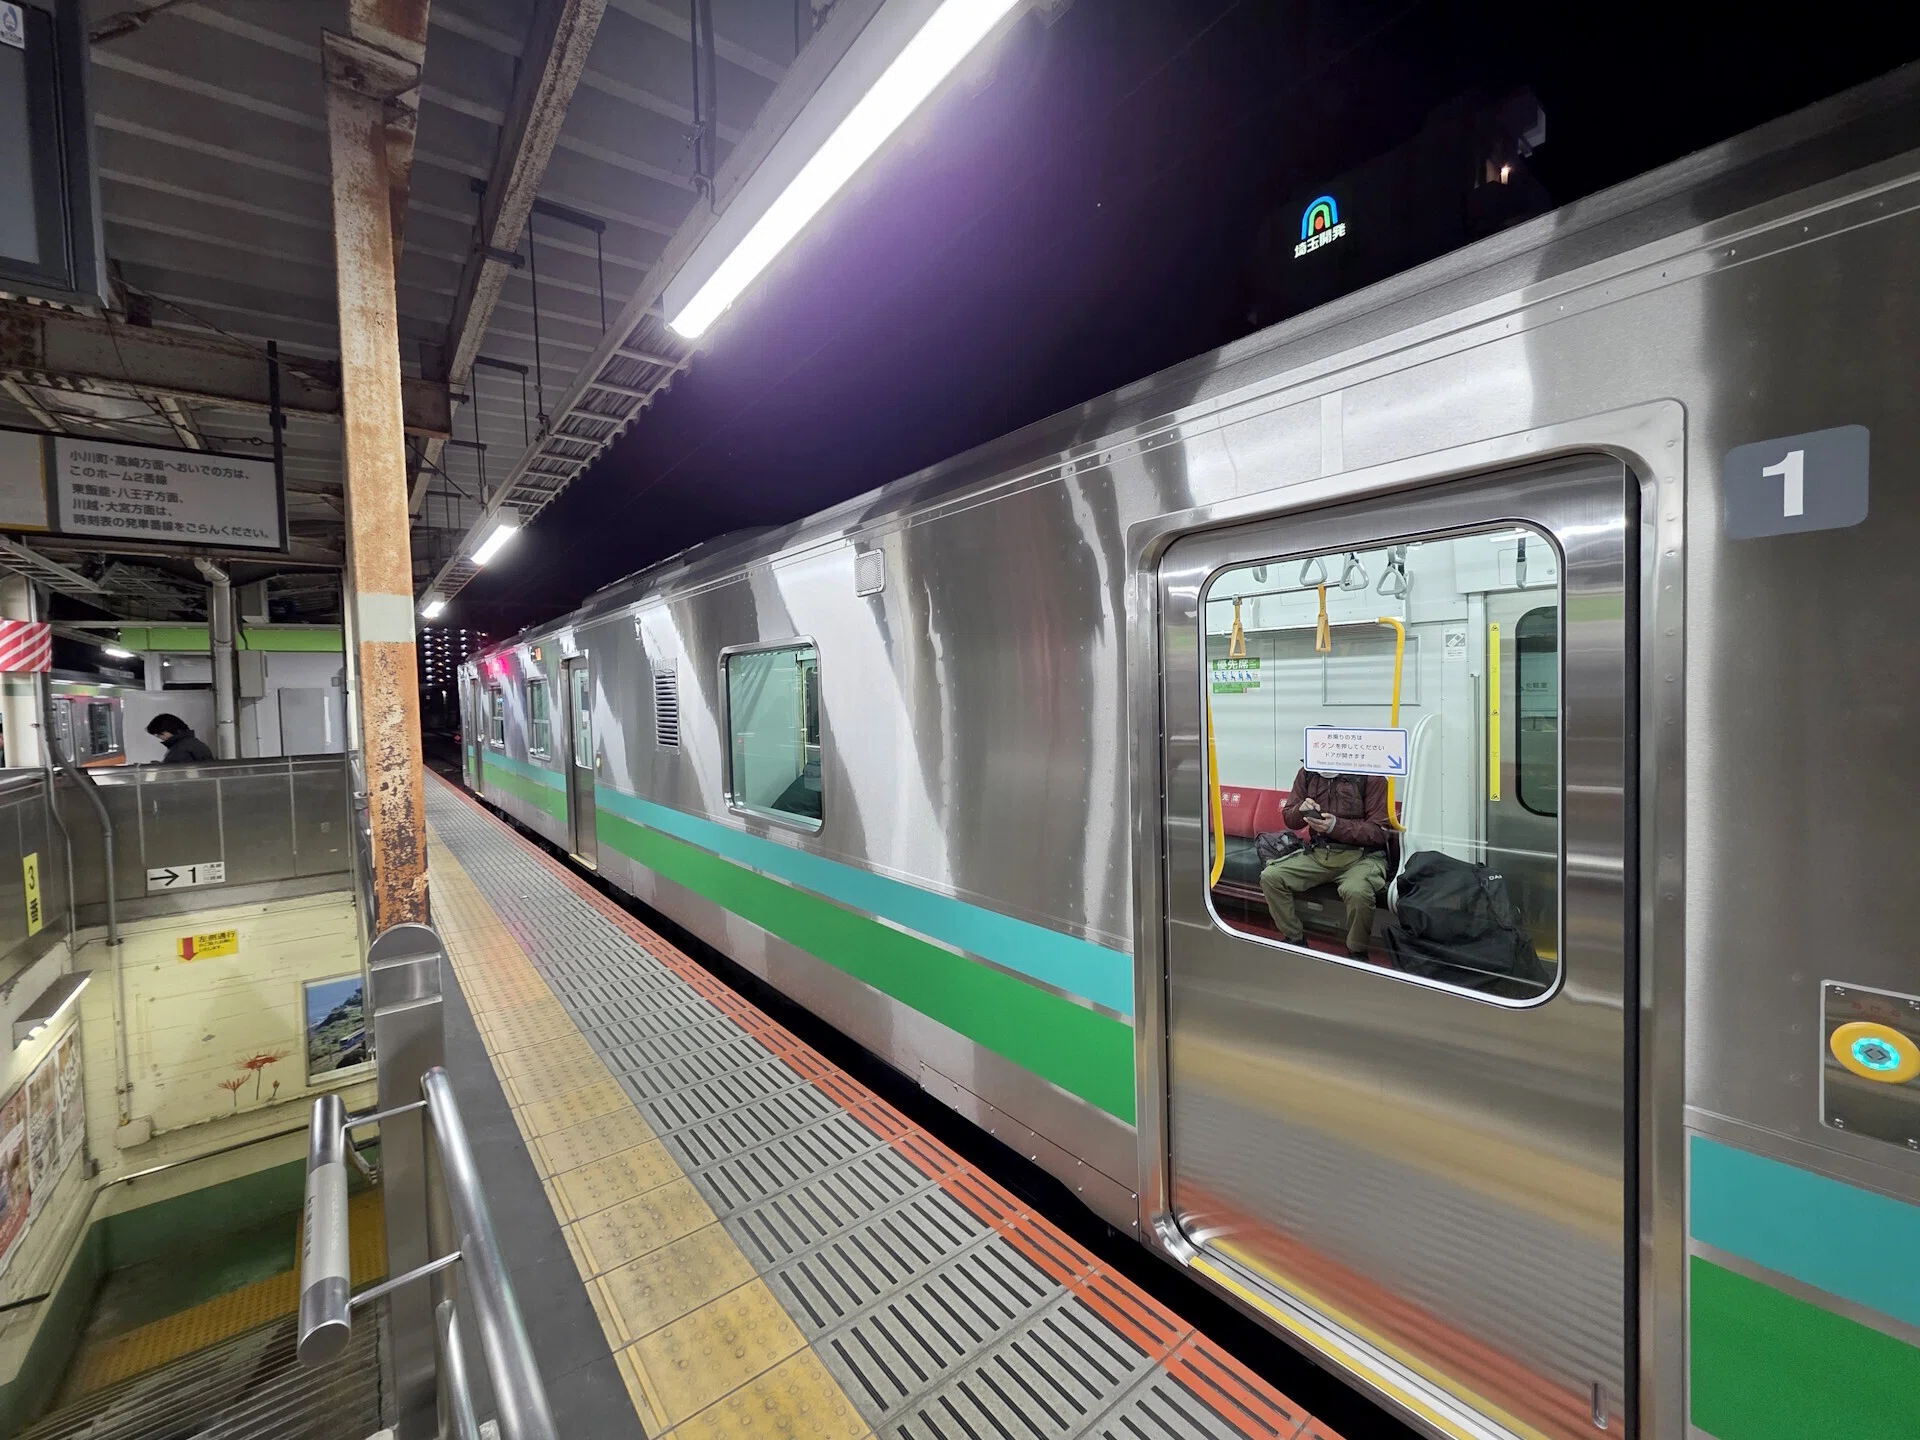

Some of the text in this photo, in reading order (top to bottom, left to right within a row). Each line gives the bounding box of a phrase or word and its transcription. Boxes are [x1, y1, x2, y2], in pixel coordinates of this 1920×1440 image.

[70, 465, 167, 485] このホーム2番線
[1762, 450, 1804, 517] 1
[72, 483, 183, 504] 東飯能・八王子方面、
[72, 498, 173, 517] 川越・大宮方面は、
[1217, 659, 1249, 670] 優先席
[1312, 741, 1385, 751] ボタンを押してください
[1327, 733, 1362, 741] お乗りの方は
[1325, 752, 1366, 760] ドアが開きます
[188, 866, 197, 884] 1
